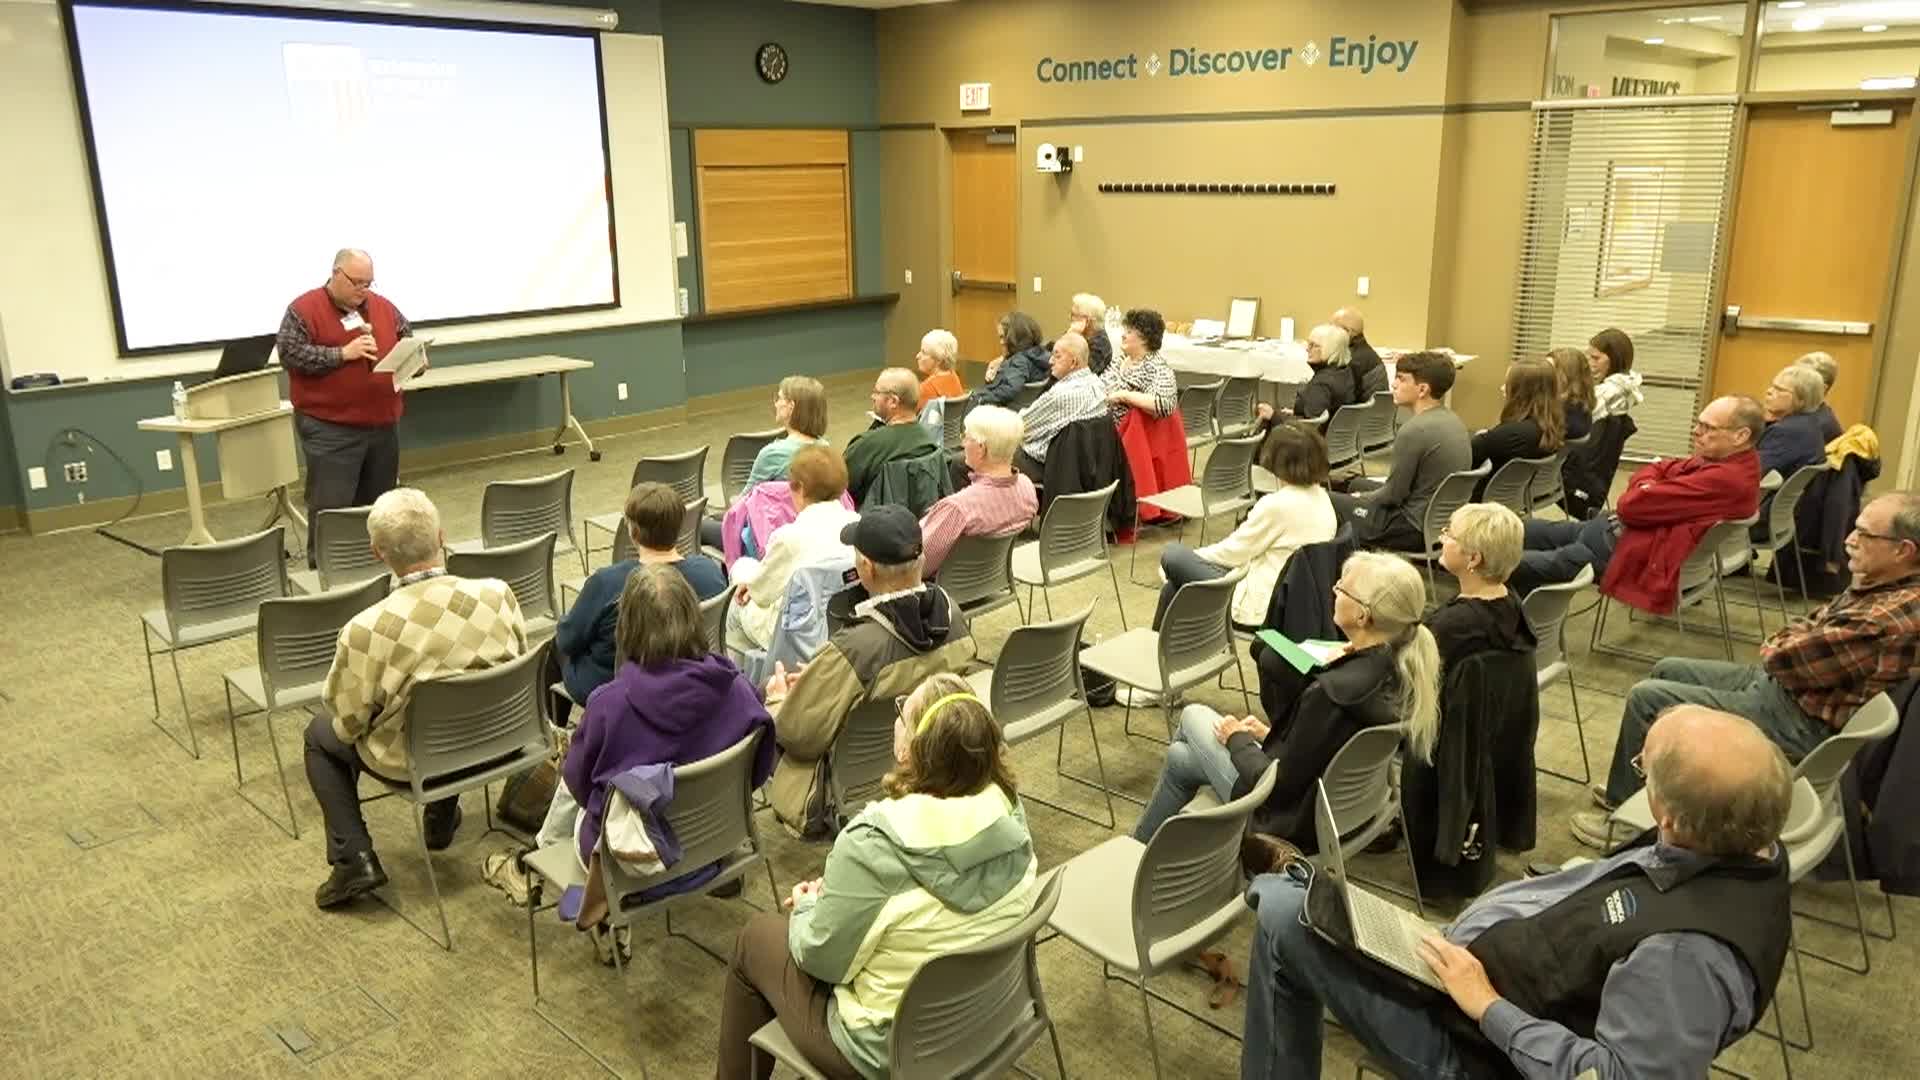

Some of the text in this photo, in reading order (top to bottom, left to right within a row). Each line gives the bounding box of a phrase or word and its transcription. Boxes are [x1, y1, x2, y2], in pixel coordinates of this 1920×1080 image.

[1037, 34, 1418, 82] Connect Discover Enjoy
[965, 87, 984, 105] EXIT
